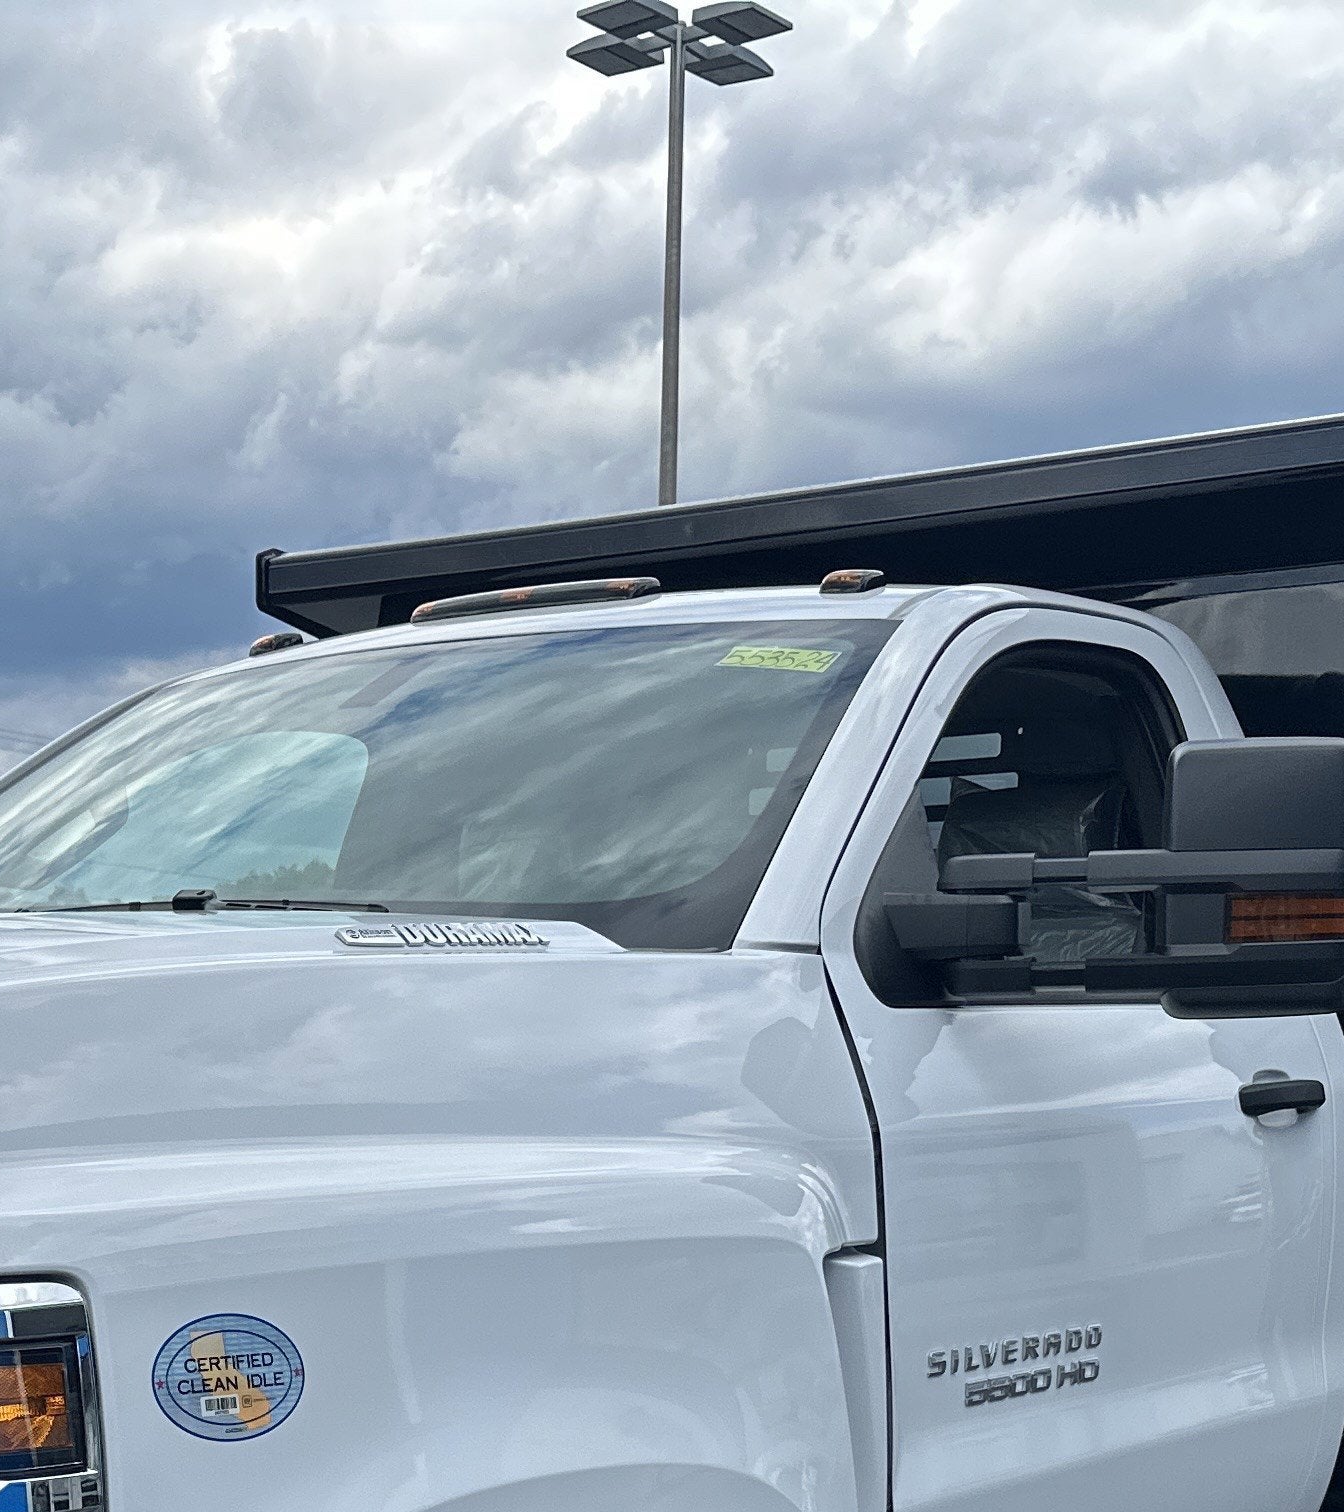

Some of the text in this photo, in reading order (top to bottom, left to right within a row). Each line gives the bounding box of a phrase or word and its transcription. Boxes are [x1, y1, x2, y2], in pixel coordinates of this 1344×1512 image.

[394, 923, 550, 947] DURAMAX
[183, 1352, 274, 1374] CERTIFIED
[926, 1323, 1104, 1379] SILVERADO
[177, 1371, 285, 1395] CLEAN IDLE
[1056, 1356, 1101, 1389] HD
